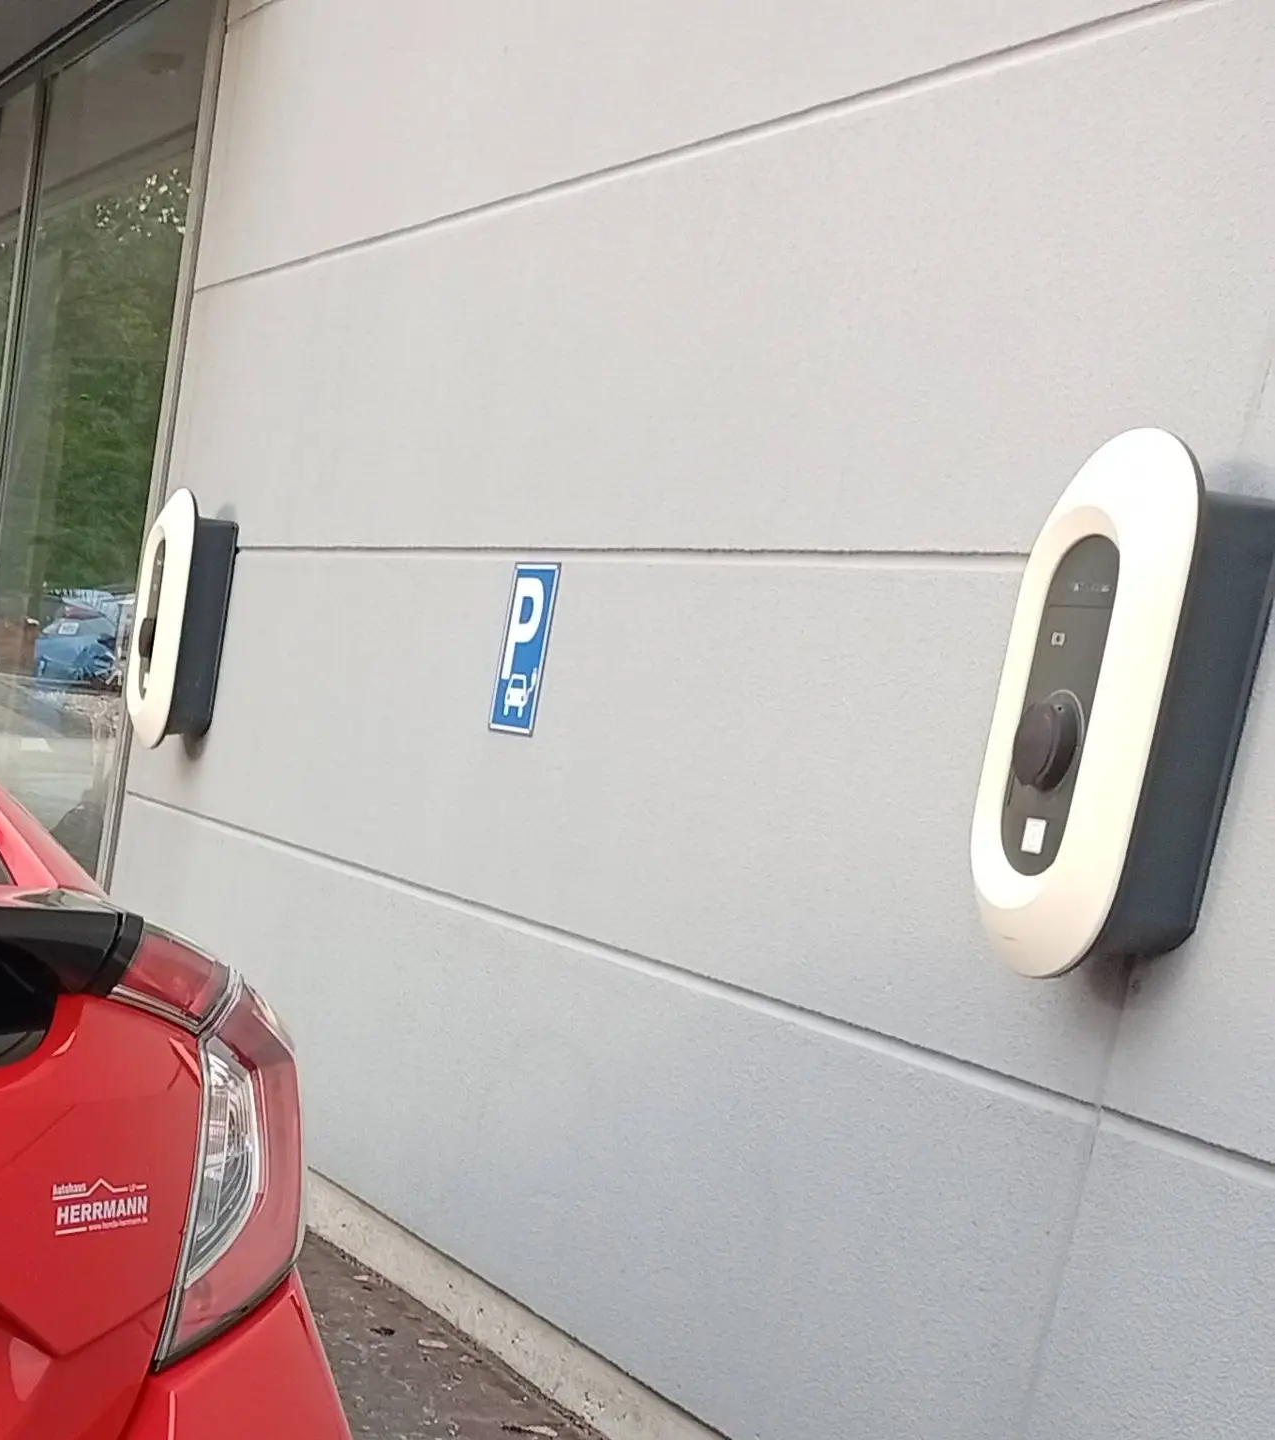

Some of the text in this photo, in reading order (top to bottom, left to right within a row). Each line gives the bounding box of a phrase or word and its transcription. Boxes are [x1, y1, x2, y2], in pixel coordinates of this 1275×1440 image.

[501, 577, 544, 680] P
[52, 1182, 87, 1196] Autohaus
[56, 1196, 148, 1225] HERRMANN
